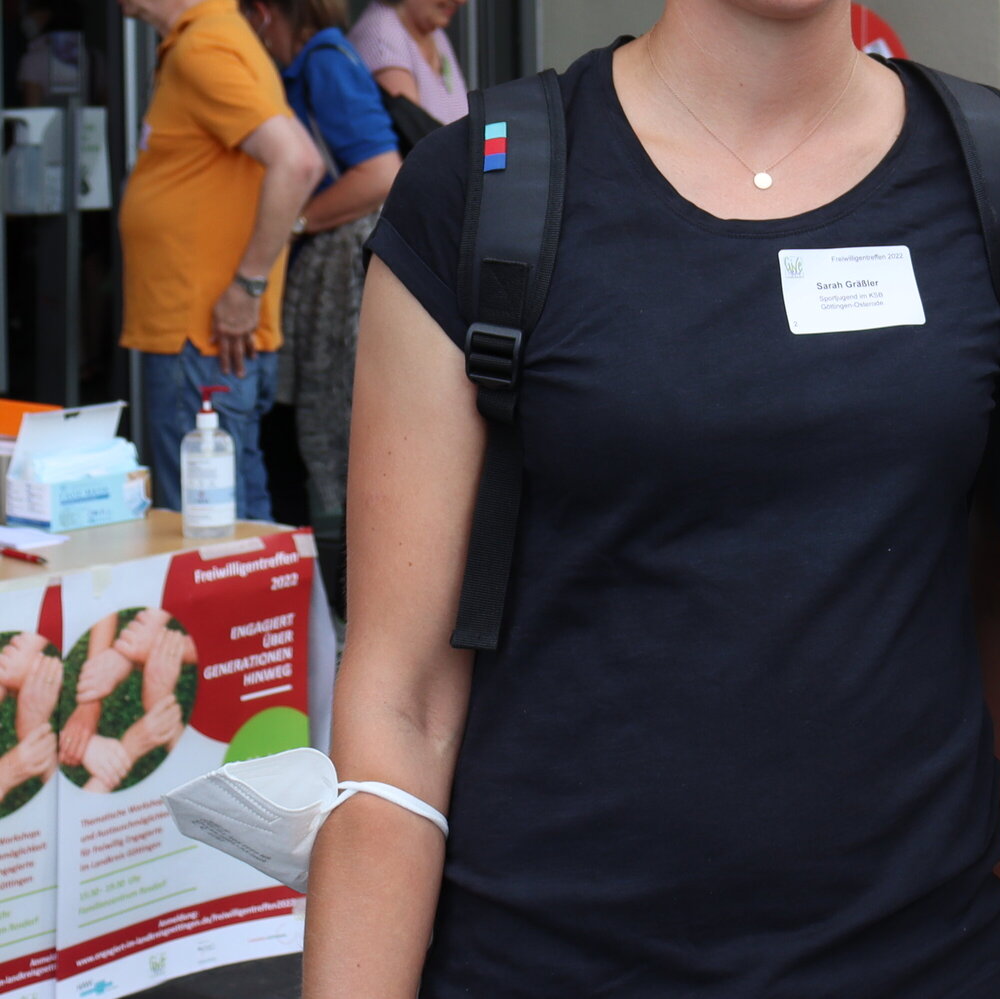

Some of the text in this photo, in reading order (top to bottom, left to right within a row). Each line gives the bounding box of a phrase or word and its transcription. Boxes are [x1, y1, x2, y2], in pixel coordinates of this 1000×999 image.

[831, 254, 886, 262] Freiwilligentreffen
[816, 280, 879, 290] Sarah Gräßler
[820, 293, 858, 302] Sportjugend
[194, 551, 299, 584] Freiwilligentreffen
[270, 572, 299, 591] 2022
[230, 612, 295, 641] ENGAGIERT
[262, 630, 294, 649] ÜBER
[203, 647, 293, 680] GENERATIONEN
[243, 663, 293, 687] HINWEG
